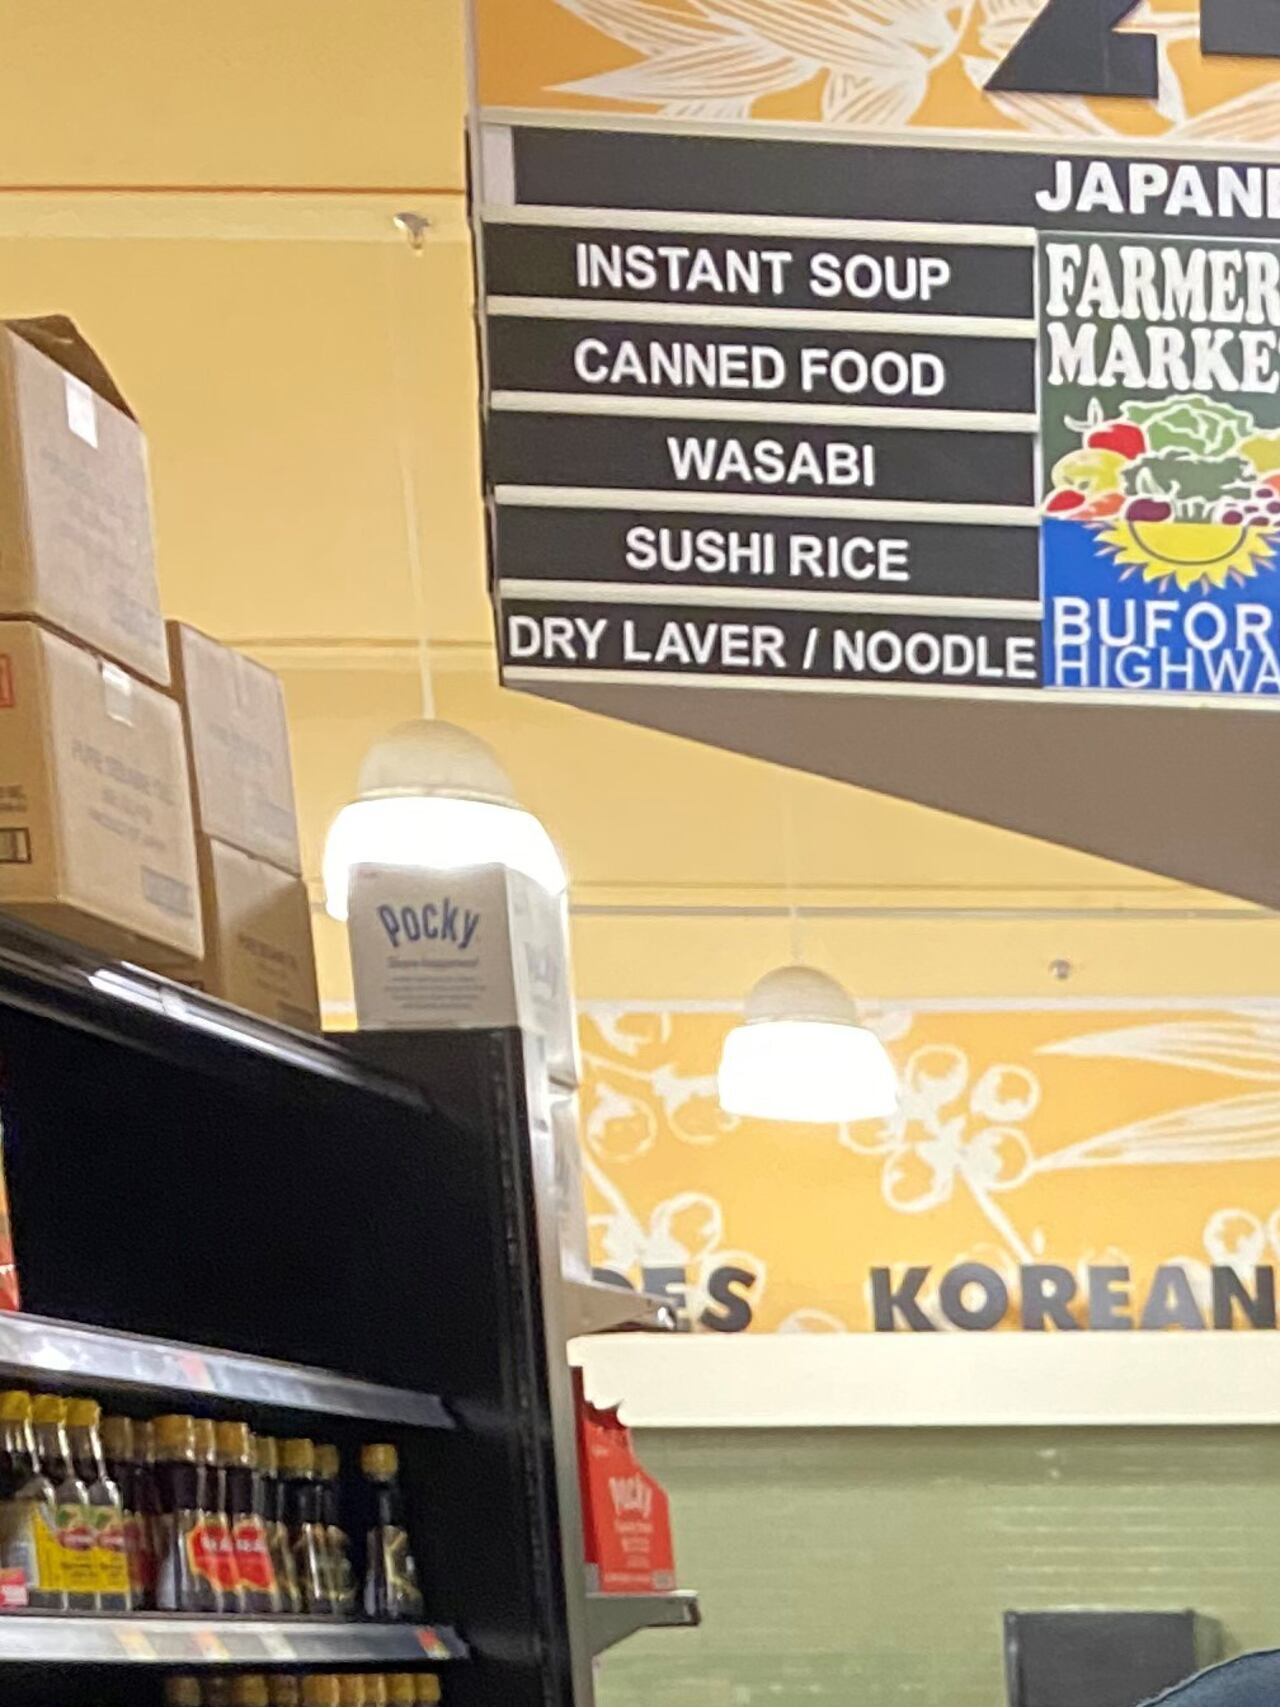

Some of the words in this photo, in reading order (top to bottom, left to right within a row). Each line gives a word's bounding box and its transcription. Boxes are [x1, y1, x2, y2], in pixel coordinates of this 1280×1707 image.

[576, 243, 793, 295] INSTANT
[810, 251, 951, 301] SOUP
[574, 337, 786, 390] CANNED
[801, 347, 946, 397] FOOD
[666, 436, 876, 487] WASABI
[624, 525, 775, 576] SUSHI
[788, 536, 910, 581] RICE
[508, 615, 607, 662] DRY
[622, 619, 787, 670] LAVER
[802, 627, 819, 671] /
[832, 629, 1038, 680] NOODLE
[869, 1262, 1278, 1332] KOREAN
